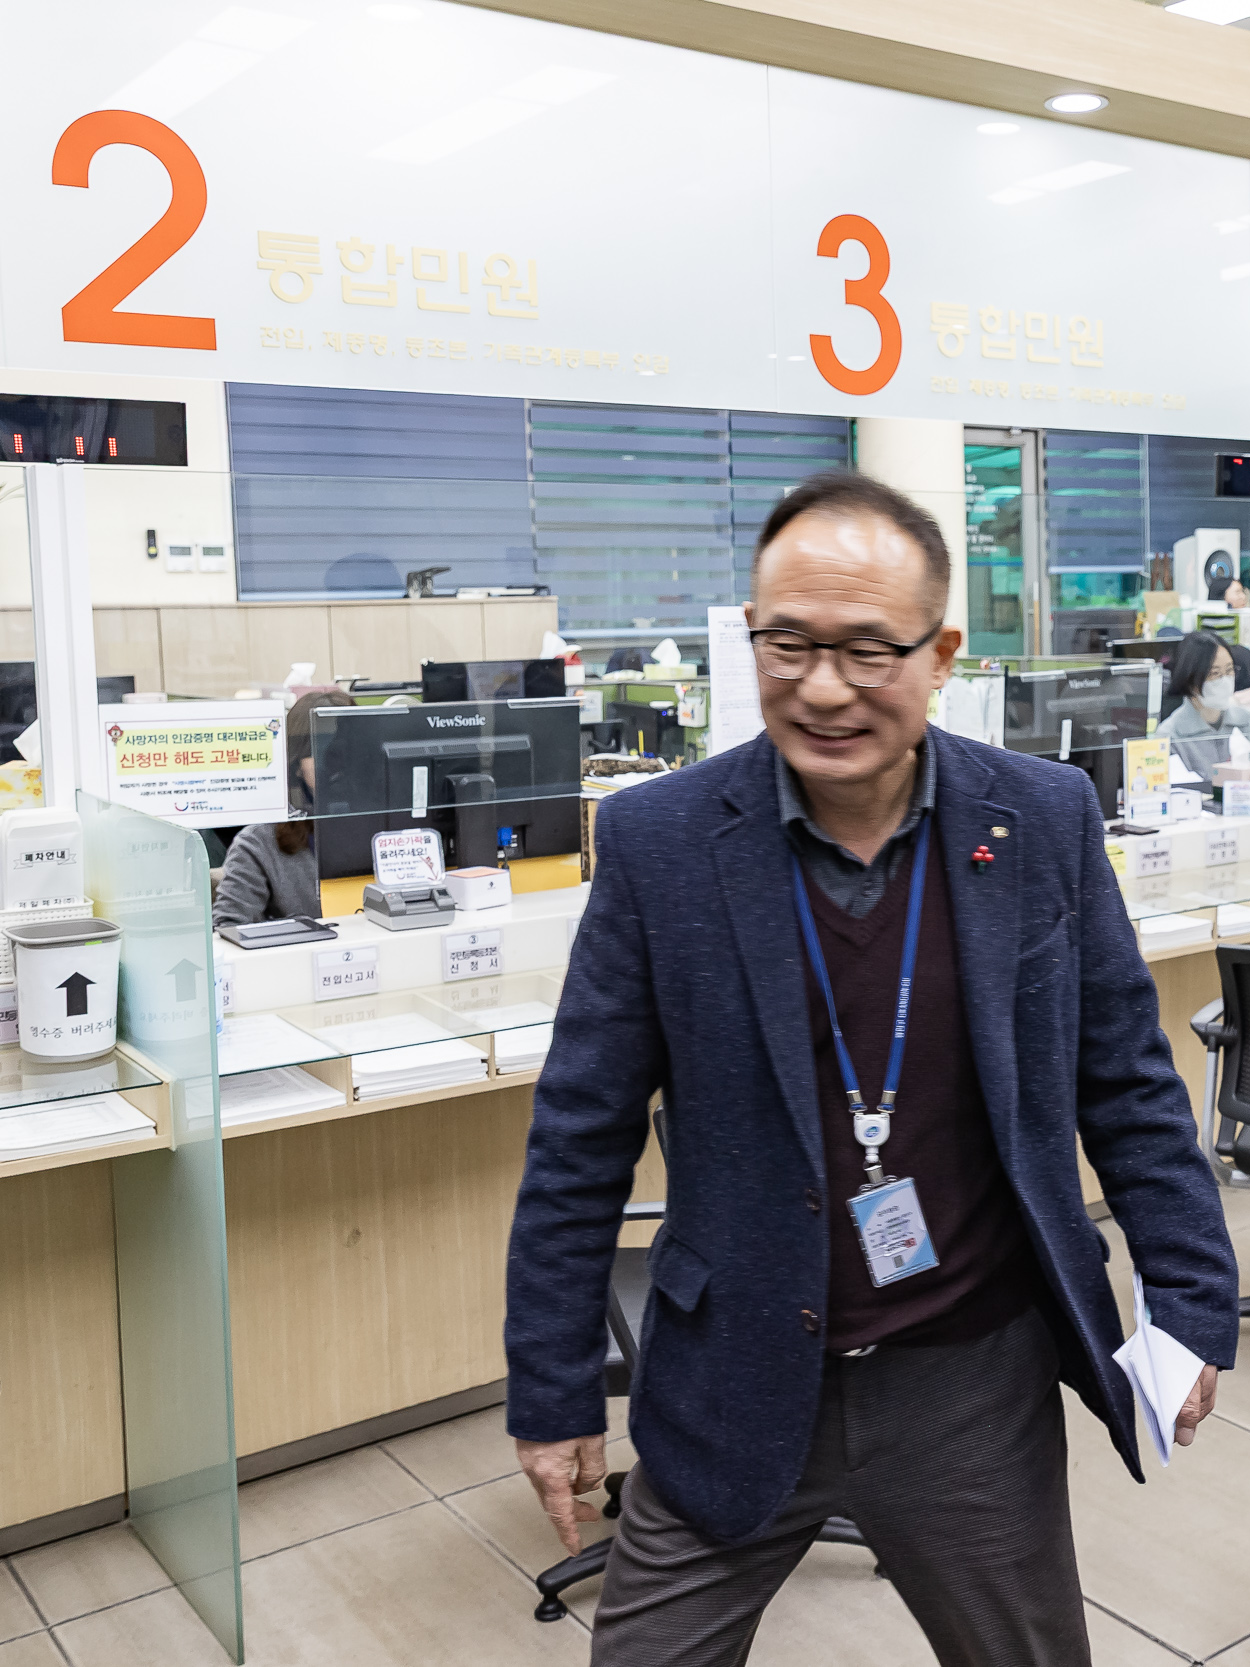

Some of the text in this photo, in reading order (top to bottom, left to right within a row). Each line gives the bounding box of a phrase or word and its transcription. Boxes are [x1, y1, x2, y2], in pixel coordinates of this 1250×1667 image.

[51, 109, 217, 351] 2
[257, 229, 540, 320] 통합민원
[809, 214, 902, 396] 3
[259, 326, 313, 351] 전입,
[930, 301, 1104, 368] 통합민원
[426, 714, 486, 728] ViewSonic
[125, 731, 267, 746] 사망자의 인감증명 대리발급은
[120, 751, 168, 769] 신청만
[174, 750, 205, 766] 해도
[378, 835, 432, 848] 엄지손가락을
[322, 970, 375, 987] 전입신고서
[30, 1025, 64, 1039] 영수증
